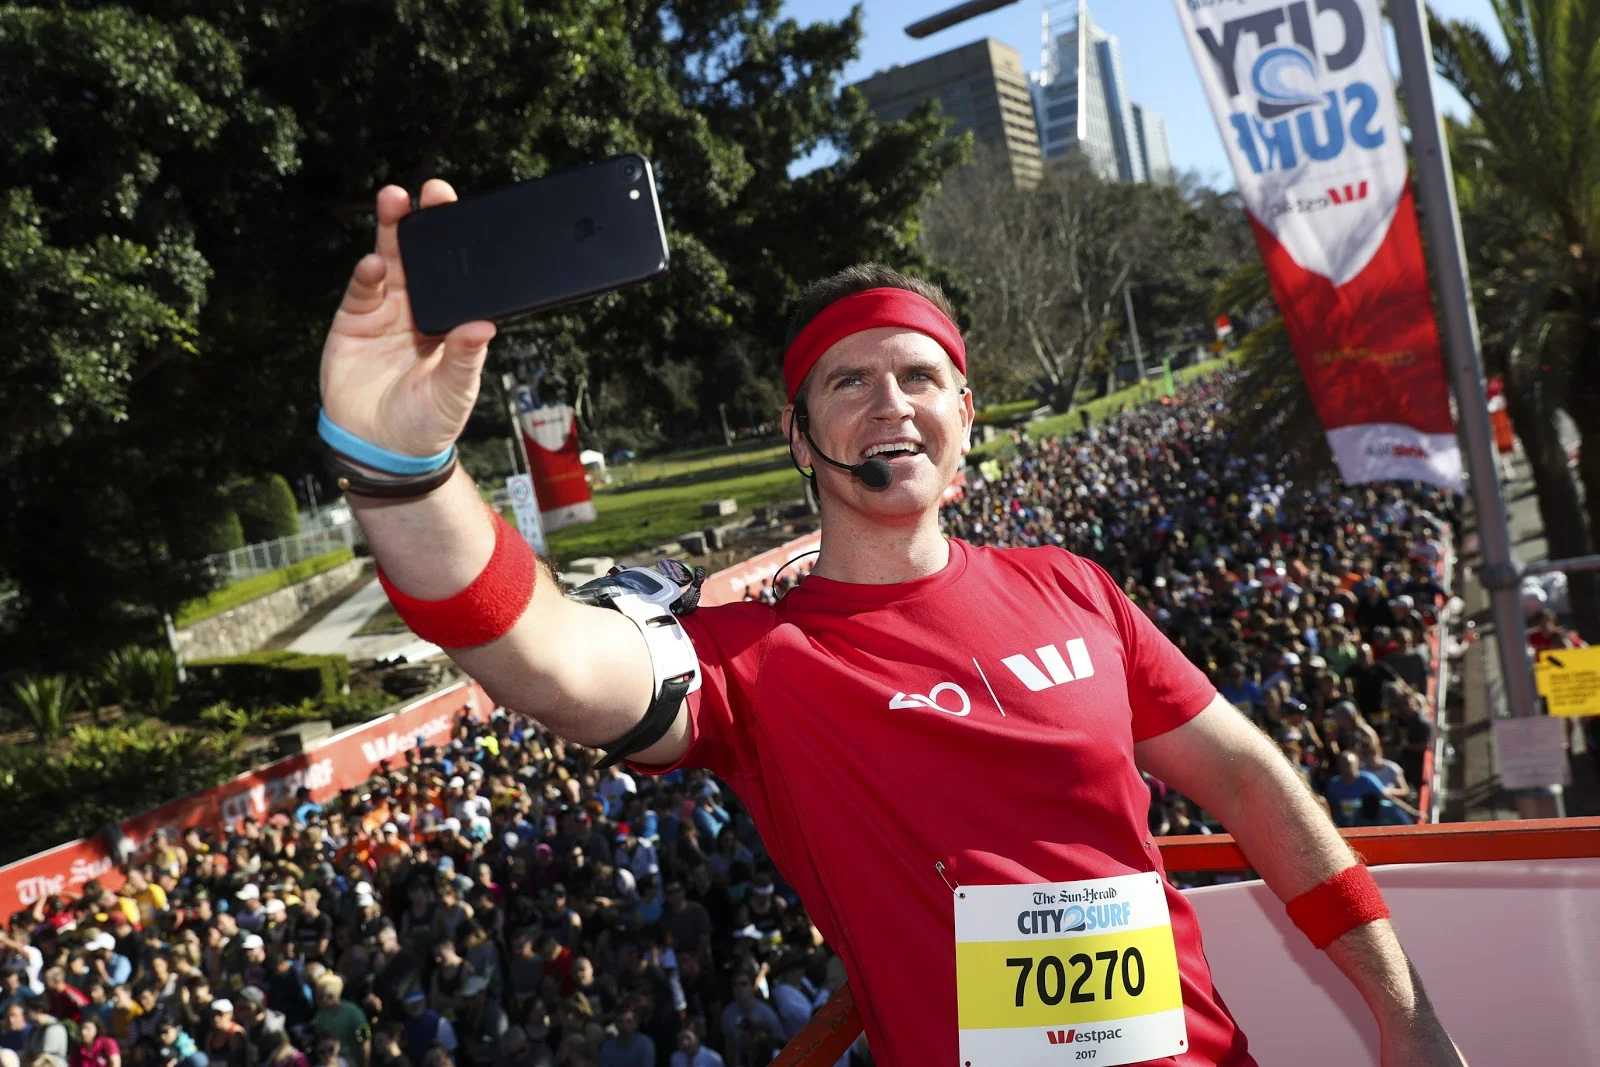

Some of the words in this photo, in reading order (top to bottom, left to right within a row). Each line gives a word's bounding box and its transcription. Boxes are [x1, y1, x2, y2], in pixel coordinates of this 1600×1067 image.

[1033, 891, 1056, 905] The
[1058, 887, 1117, 904] Sun-Herald
[1006, 946, 1145, 1007] 70270
[1047, 1028, 1122, 1044] Westpac
[1075, 1050, 1097, 1060] 2017
